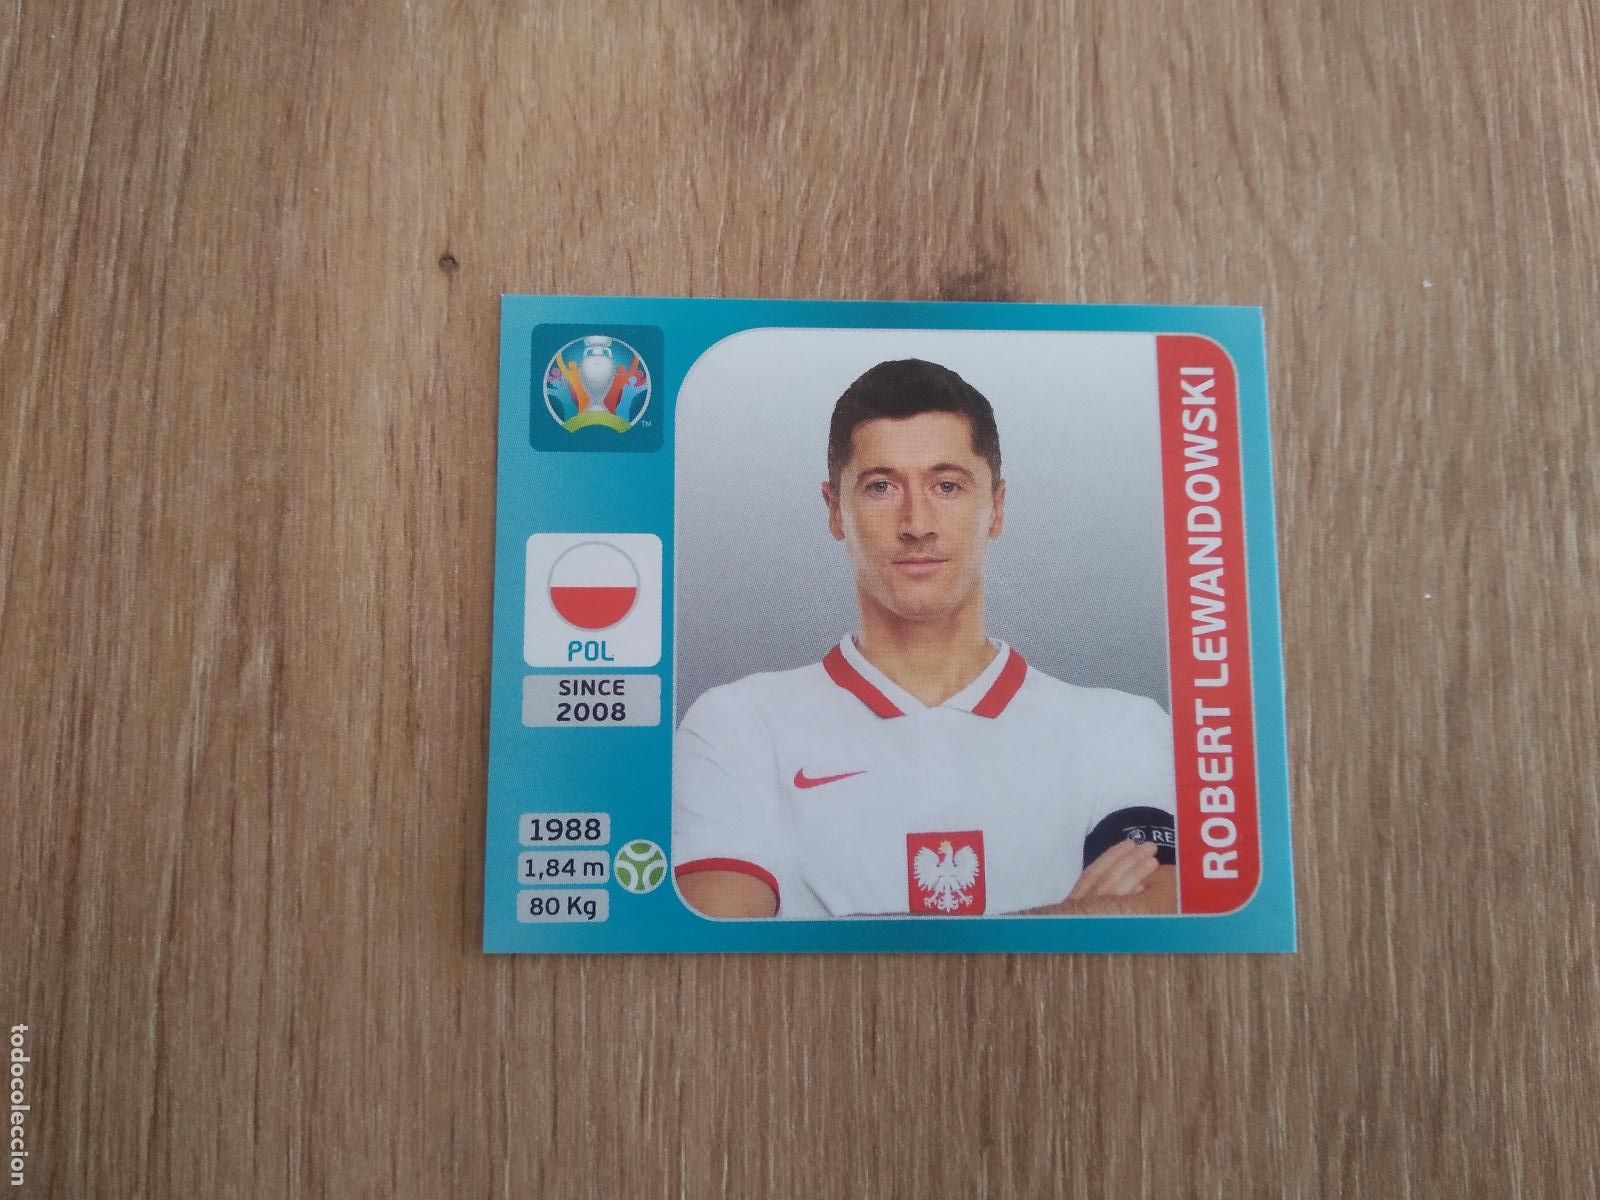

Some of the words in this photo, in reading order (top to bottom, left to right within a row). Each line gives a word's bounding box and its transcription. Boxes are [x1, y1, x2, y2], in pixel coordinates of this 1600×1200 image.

[1180, 366, 1232, 688] LEWANDOWSKI
[568, 640, 615, 661] POL
[559, 679, 625, 696] SINCE
[556, 702, 626, 722] 2008
[1195, 697, 1239, 880] ROBERT
[530, 818, 601, 841] 1988
[525, 858, 576, 880] 1,84
[583, 861, 604, 876] m
[530, 897, 560, 916] 80
[567, 896, 597, 920] Kg
